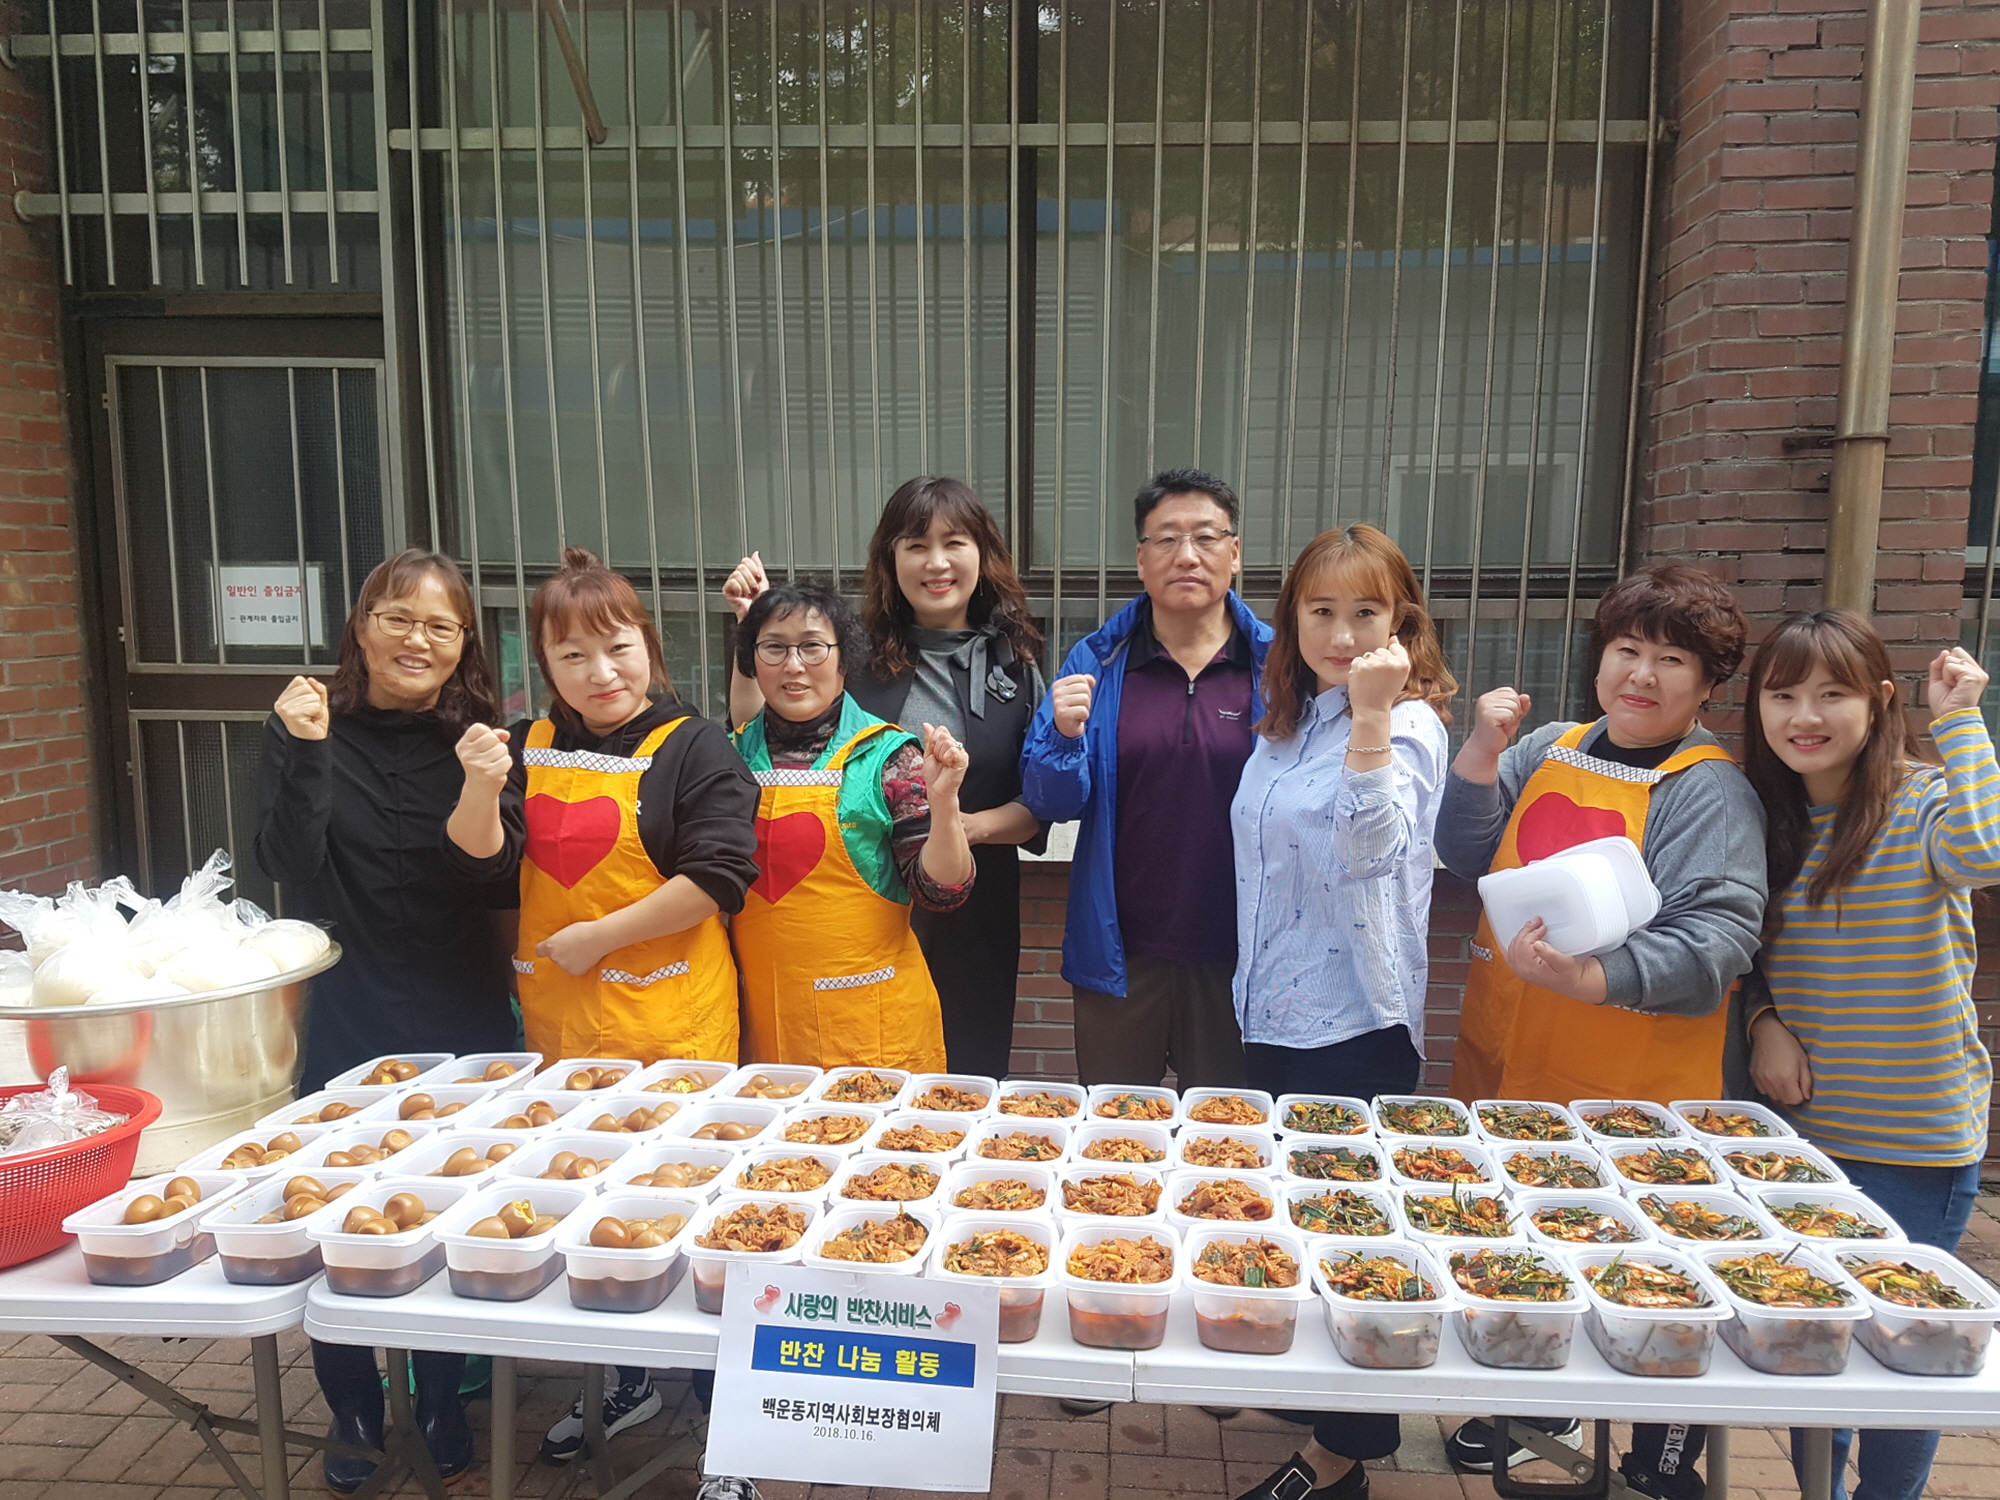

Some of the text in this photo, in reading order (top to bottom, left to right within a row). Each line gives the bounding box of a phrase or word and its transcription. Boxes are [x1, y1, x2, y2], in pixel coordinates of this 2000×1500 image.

[226, 585, 257, 597] 일반인
[271, 614, 298, 623] 출입금지
[784, 1292, 932, 1328] 사랑의 반찬서비스
[780, 1340, 940, 1378] 반찬 나눔 활동
[762, 1397, 941, 1433] 백운동지역사회보장협의체
[813, 1426, 876, 1441] 2018.10.16.
